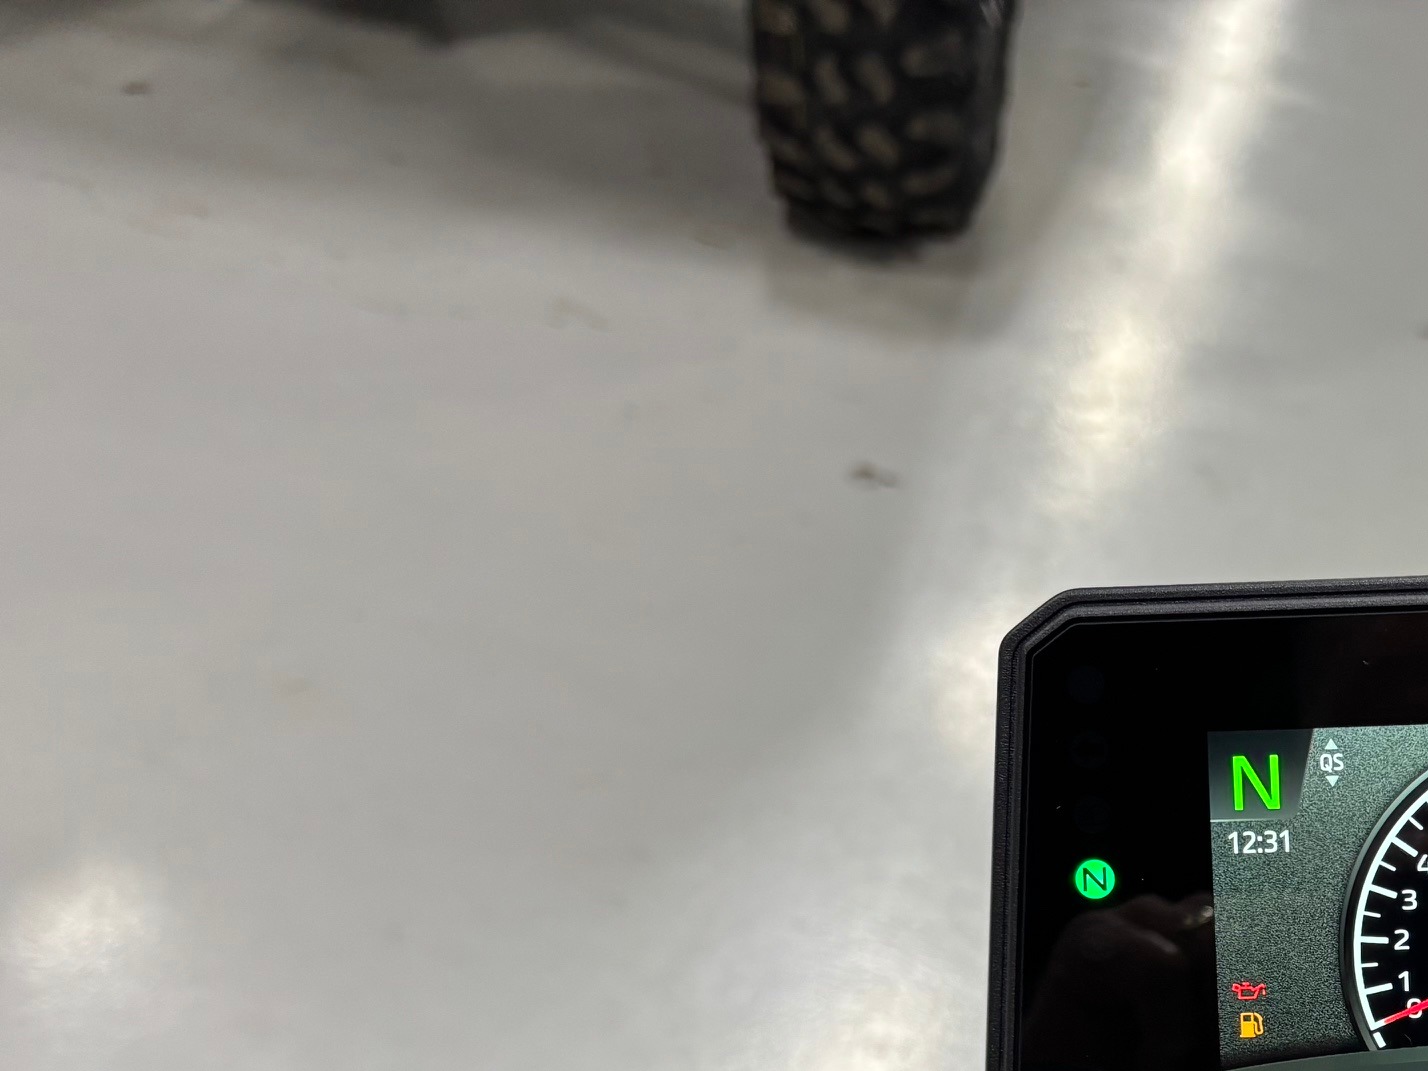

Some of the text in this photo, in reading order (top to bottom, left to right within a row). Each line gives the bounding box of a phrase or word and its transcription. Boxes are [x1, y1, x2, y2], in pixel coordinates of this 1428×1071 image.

[1319, 752, 1344, 772] QS
[1232, 754, 1281, 811] N
[1228, 829, 1290, 854] 12:31
[1082, 866, 1108, 892] N
[1401, 889, 1418, 911] 3
[1394, 929, 1410, 951] 2
[1398, 970, 1410, 992] 1
